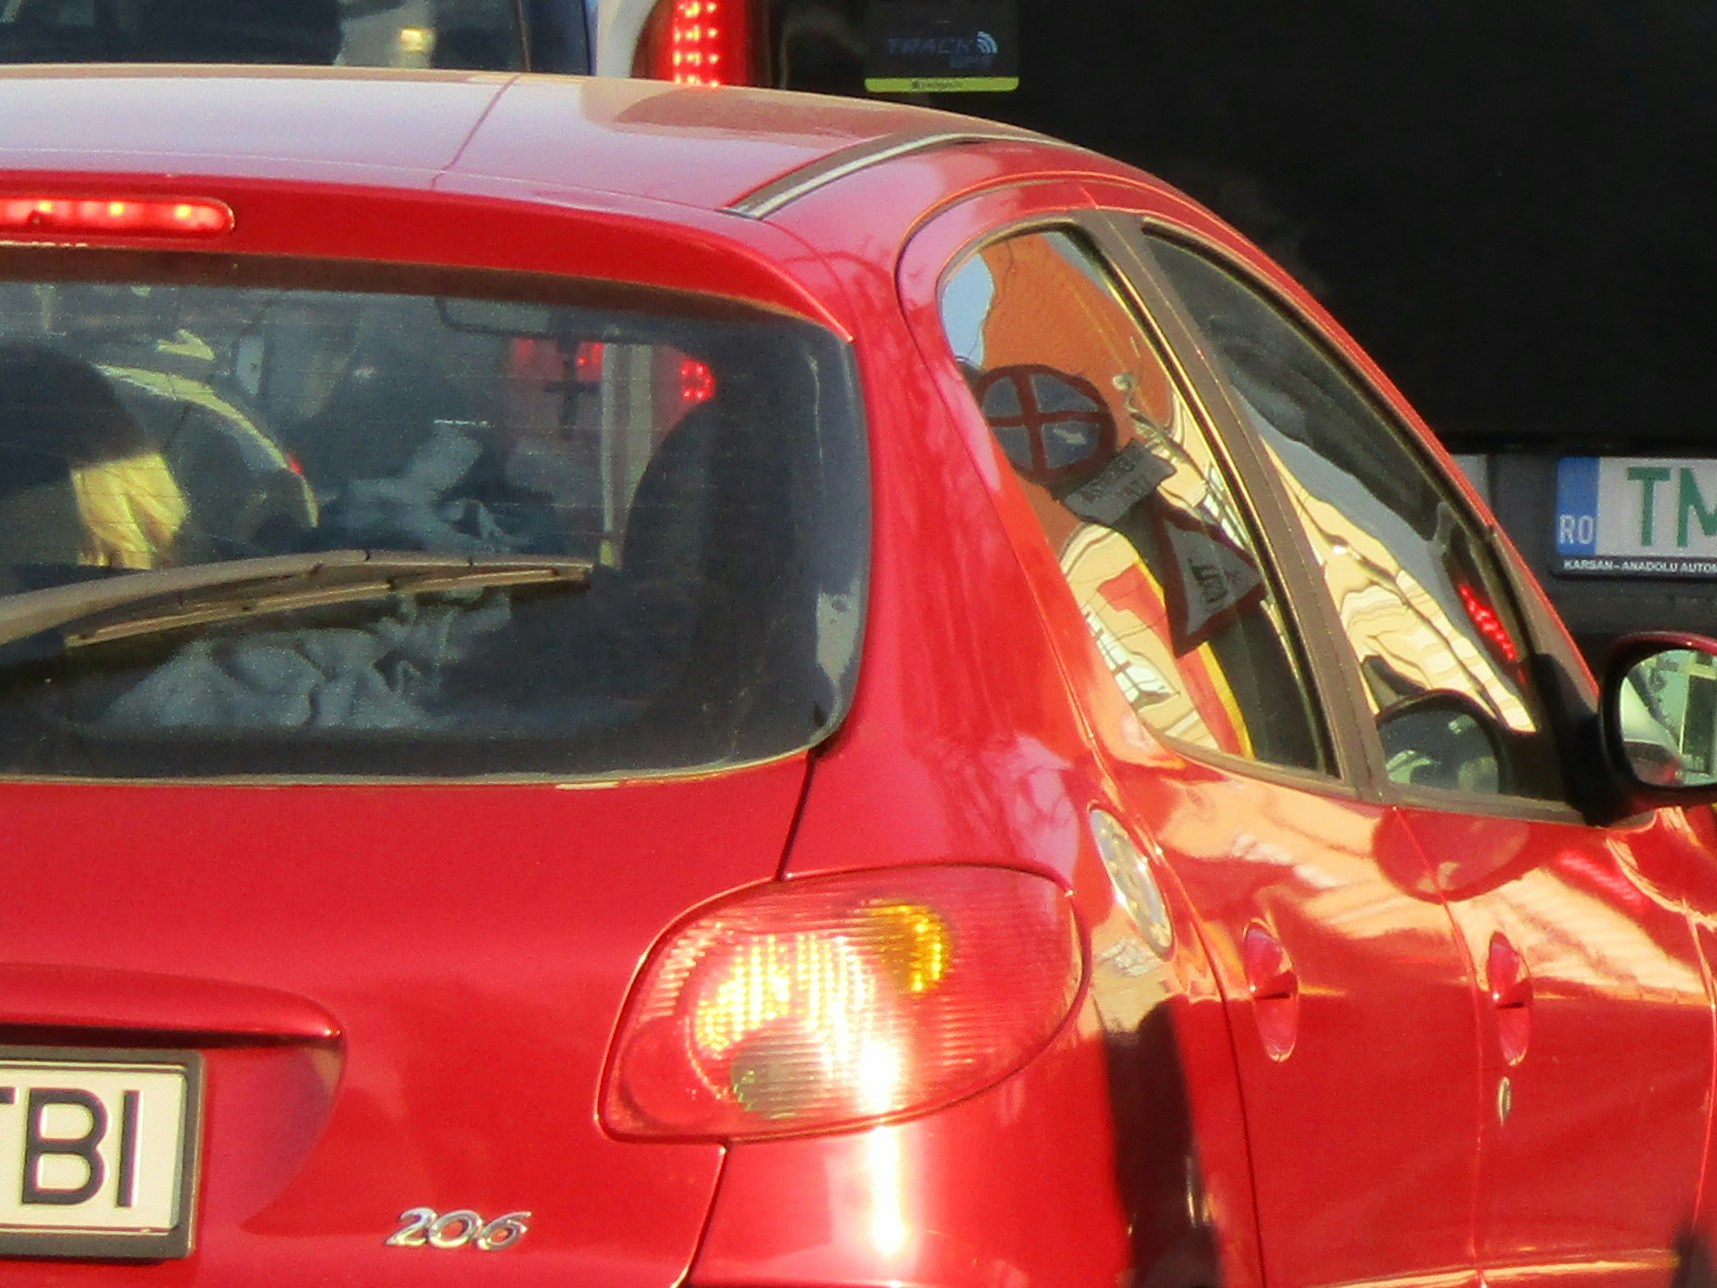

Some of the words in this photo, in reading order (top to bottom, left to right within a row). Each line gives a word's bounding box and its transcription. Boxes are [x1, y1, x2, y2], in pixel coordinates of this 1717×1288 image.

[1559, 514, 1594, 546] RO
[0, 1087, 143, 1209] BI
[384, 1207, 533, 1252] 206
